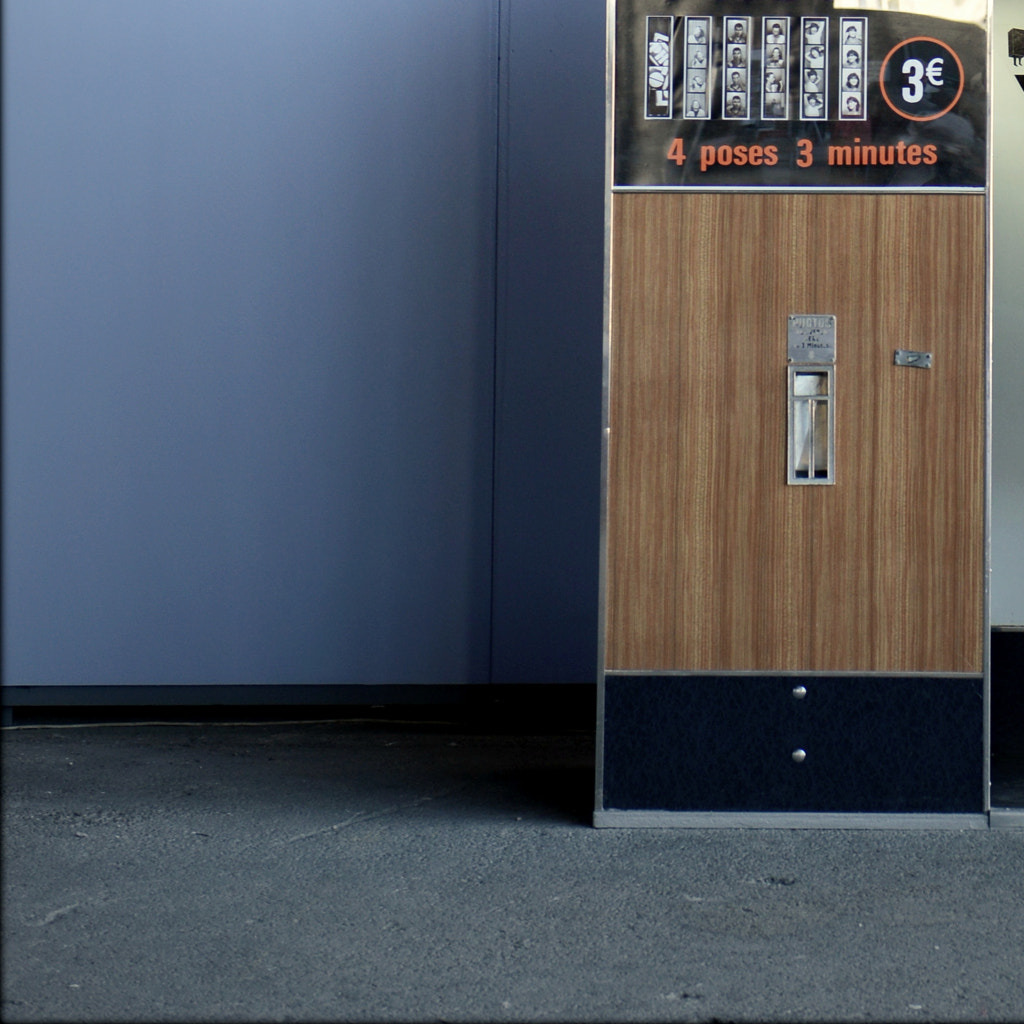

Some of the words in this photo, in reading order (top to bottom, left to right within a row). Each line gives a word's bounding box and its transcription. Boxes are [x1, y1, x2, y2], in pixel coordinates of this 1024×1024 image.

[901, 57, 945, 104] 3€
[667, 138, 686, 166] 4
[700, 143, 778, 172] poses
[796, 138, 814, 167] 3
[828, 137, 938, 166] minutes
